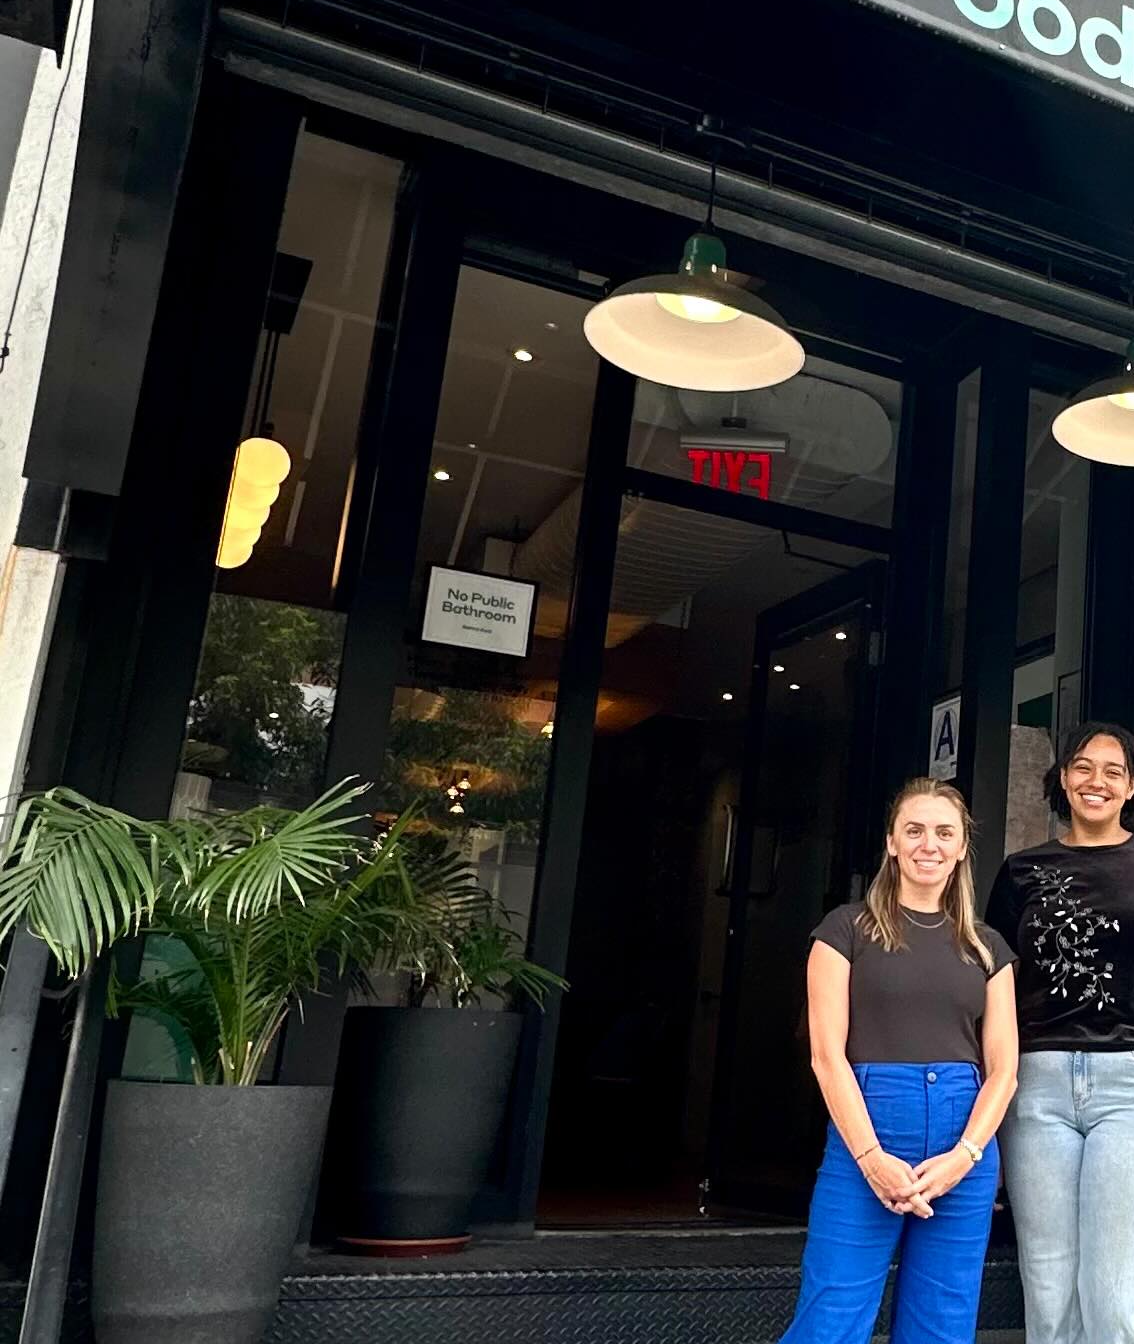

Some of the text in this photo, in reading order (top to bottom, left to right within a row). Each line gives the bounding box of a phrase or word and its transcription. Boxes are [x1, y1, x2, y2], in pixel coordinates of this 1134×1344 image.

[447, 588, 515, 610] No Public
[442, 601, 517, 624] Bathroom
[934, 710, 955, 762] A
